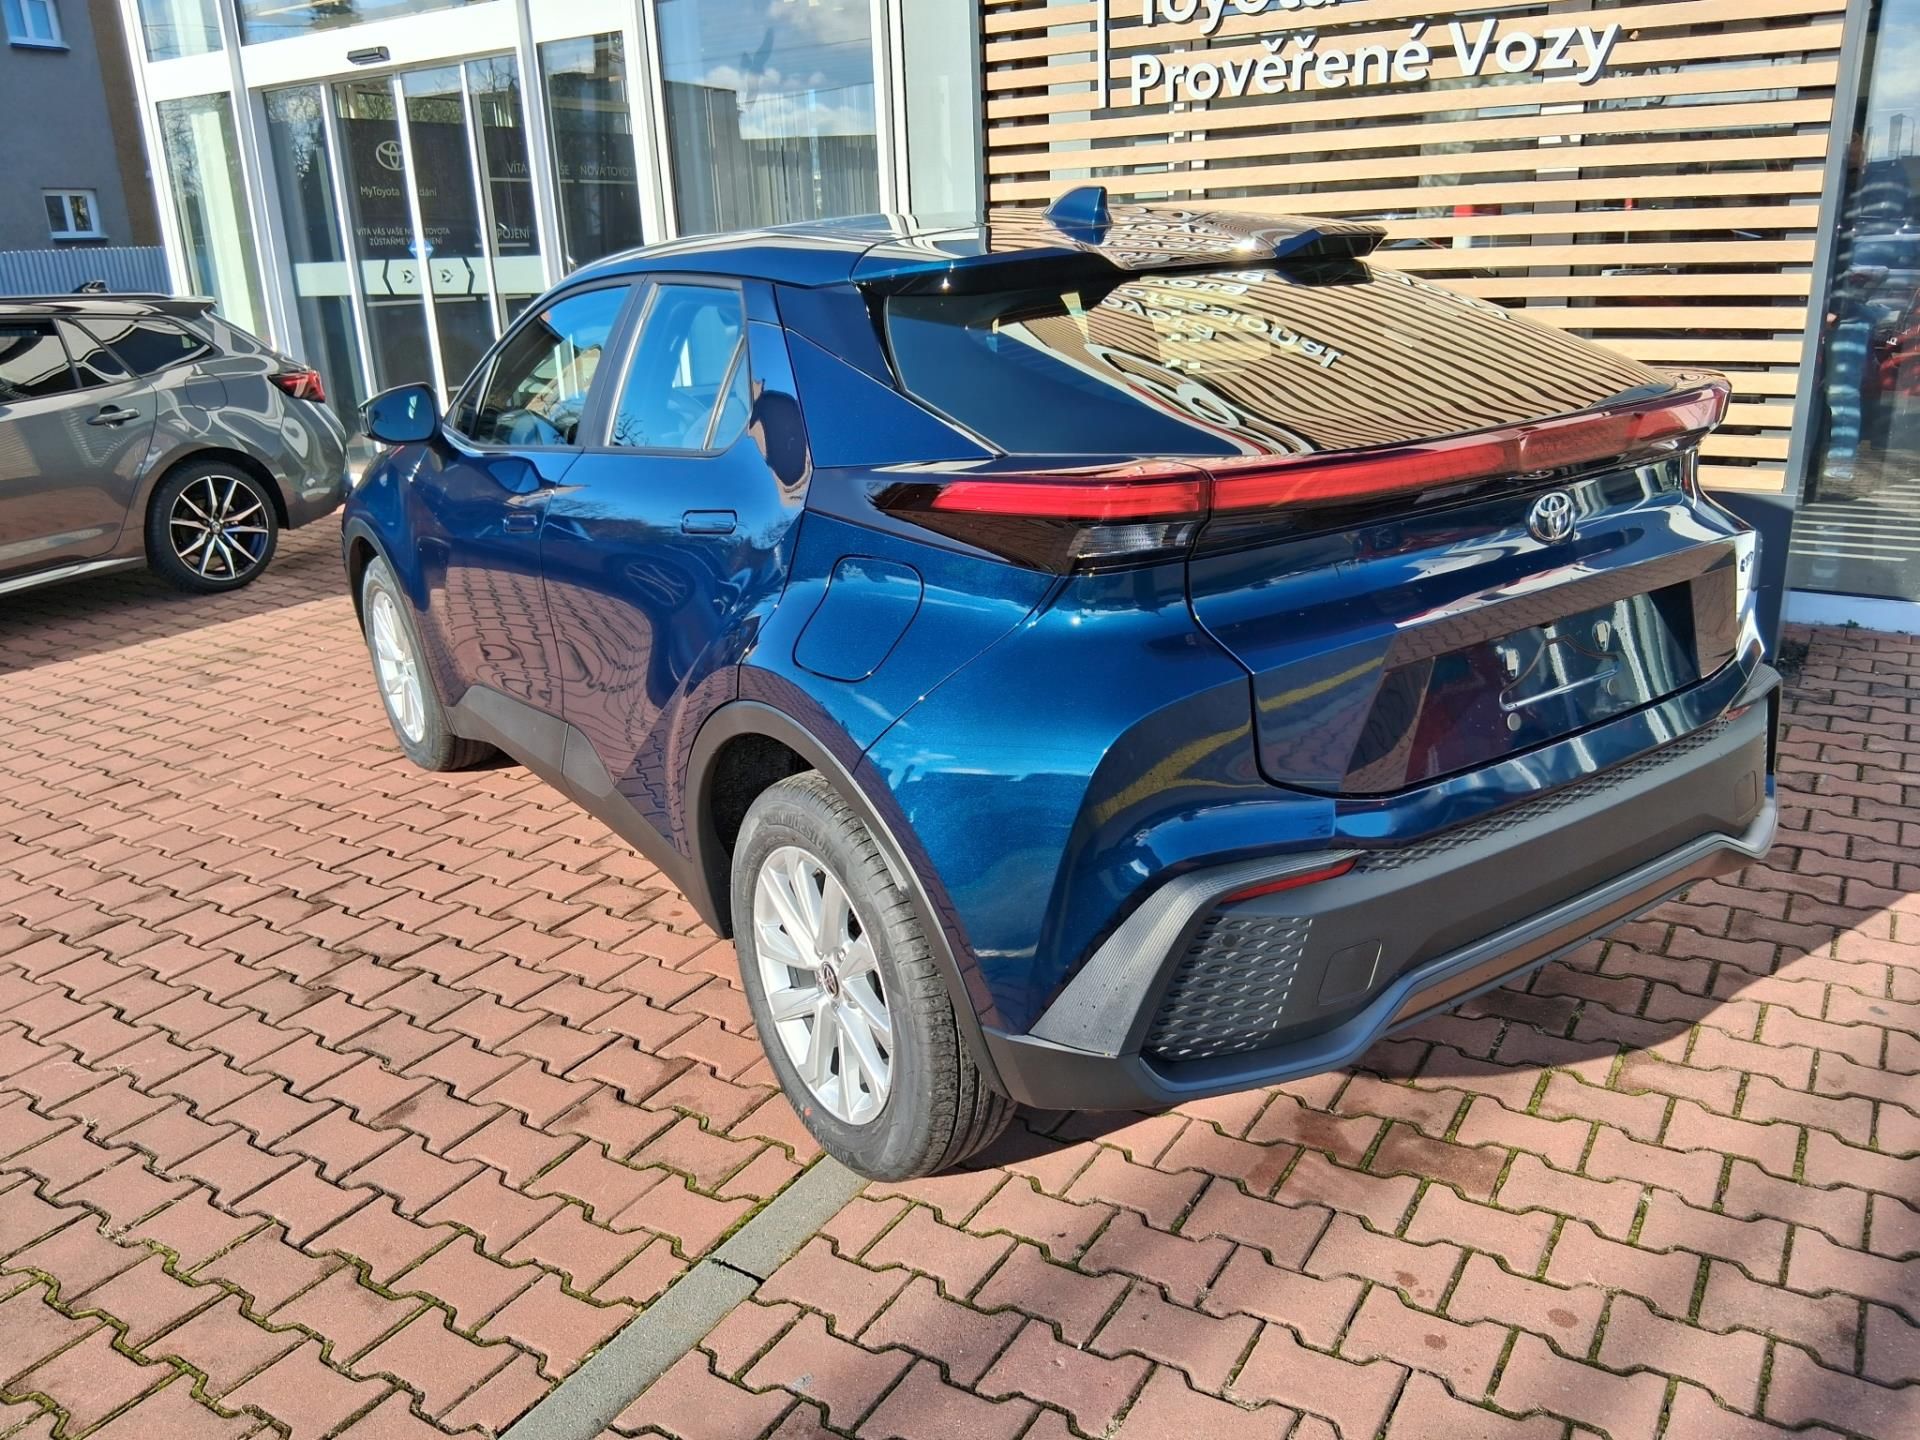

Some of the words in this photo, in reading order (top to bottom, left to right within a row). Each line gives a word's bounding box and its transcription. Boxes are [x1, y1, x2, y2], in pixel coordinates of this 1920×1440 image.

[1131, 23, 1430, 105] Prověřené
[1449, 19, 1622, 84] Vozy
[606, 166, 634, 177] TOYOT
[360, 186, 401, 198] MyToyota
[497, 226, 530, 240] POJENÍ
